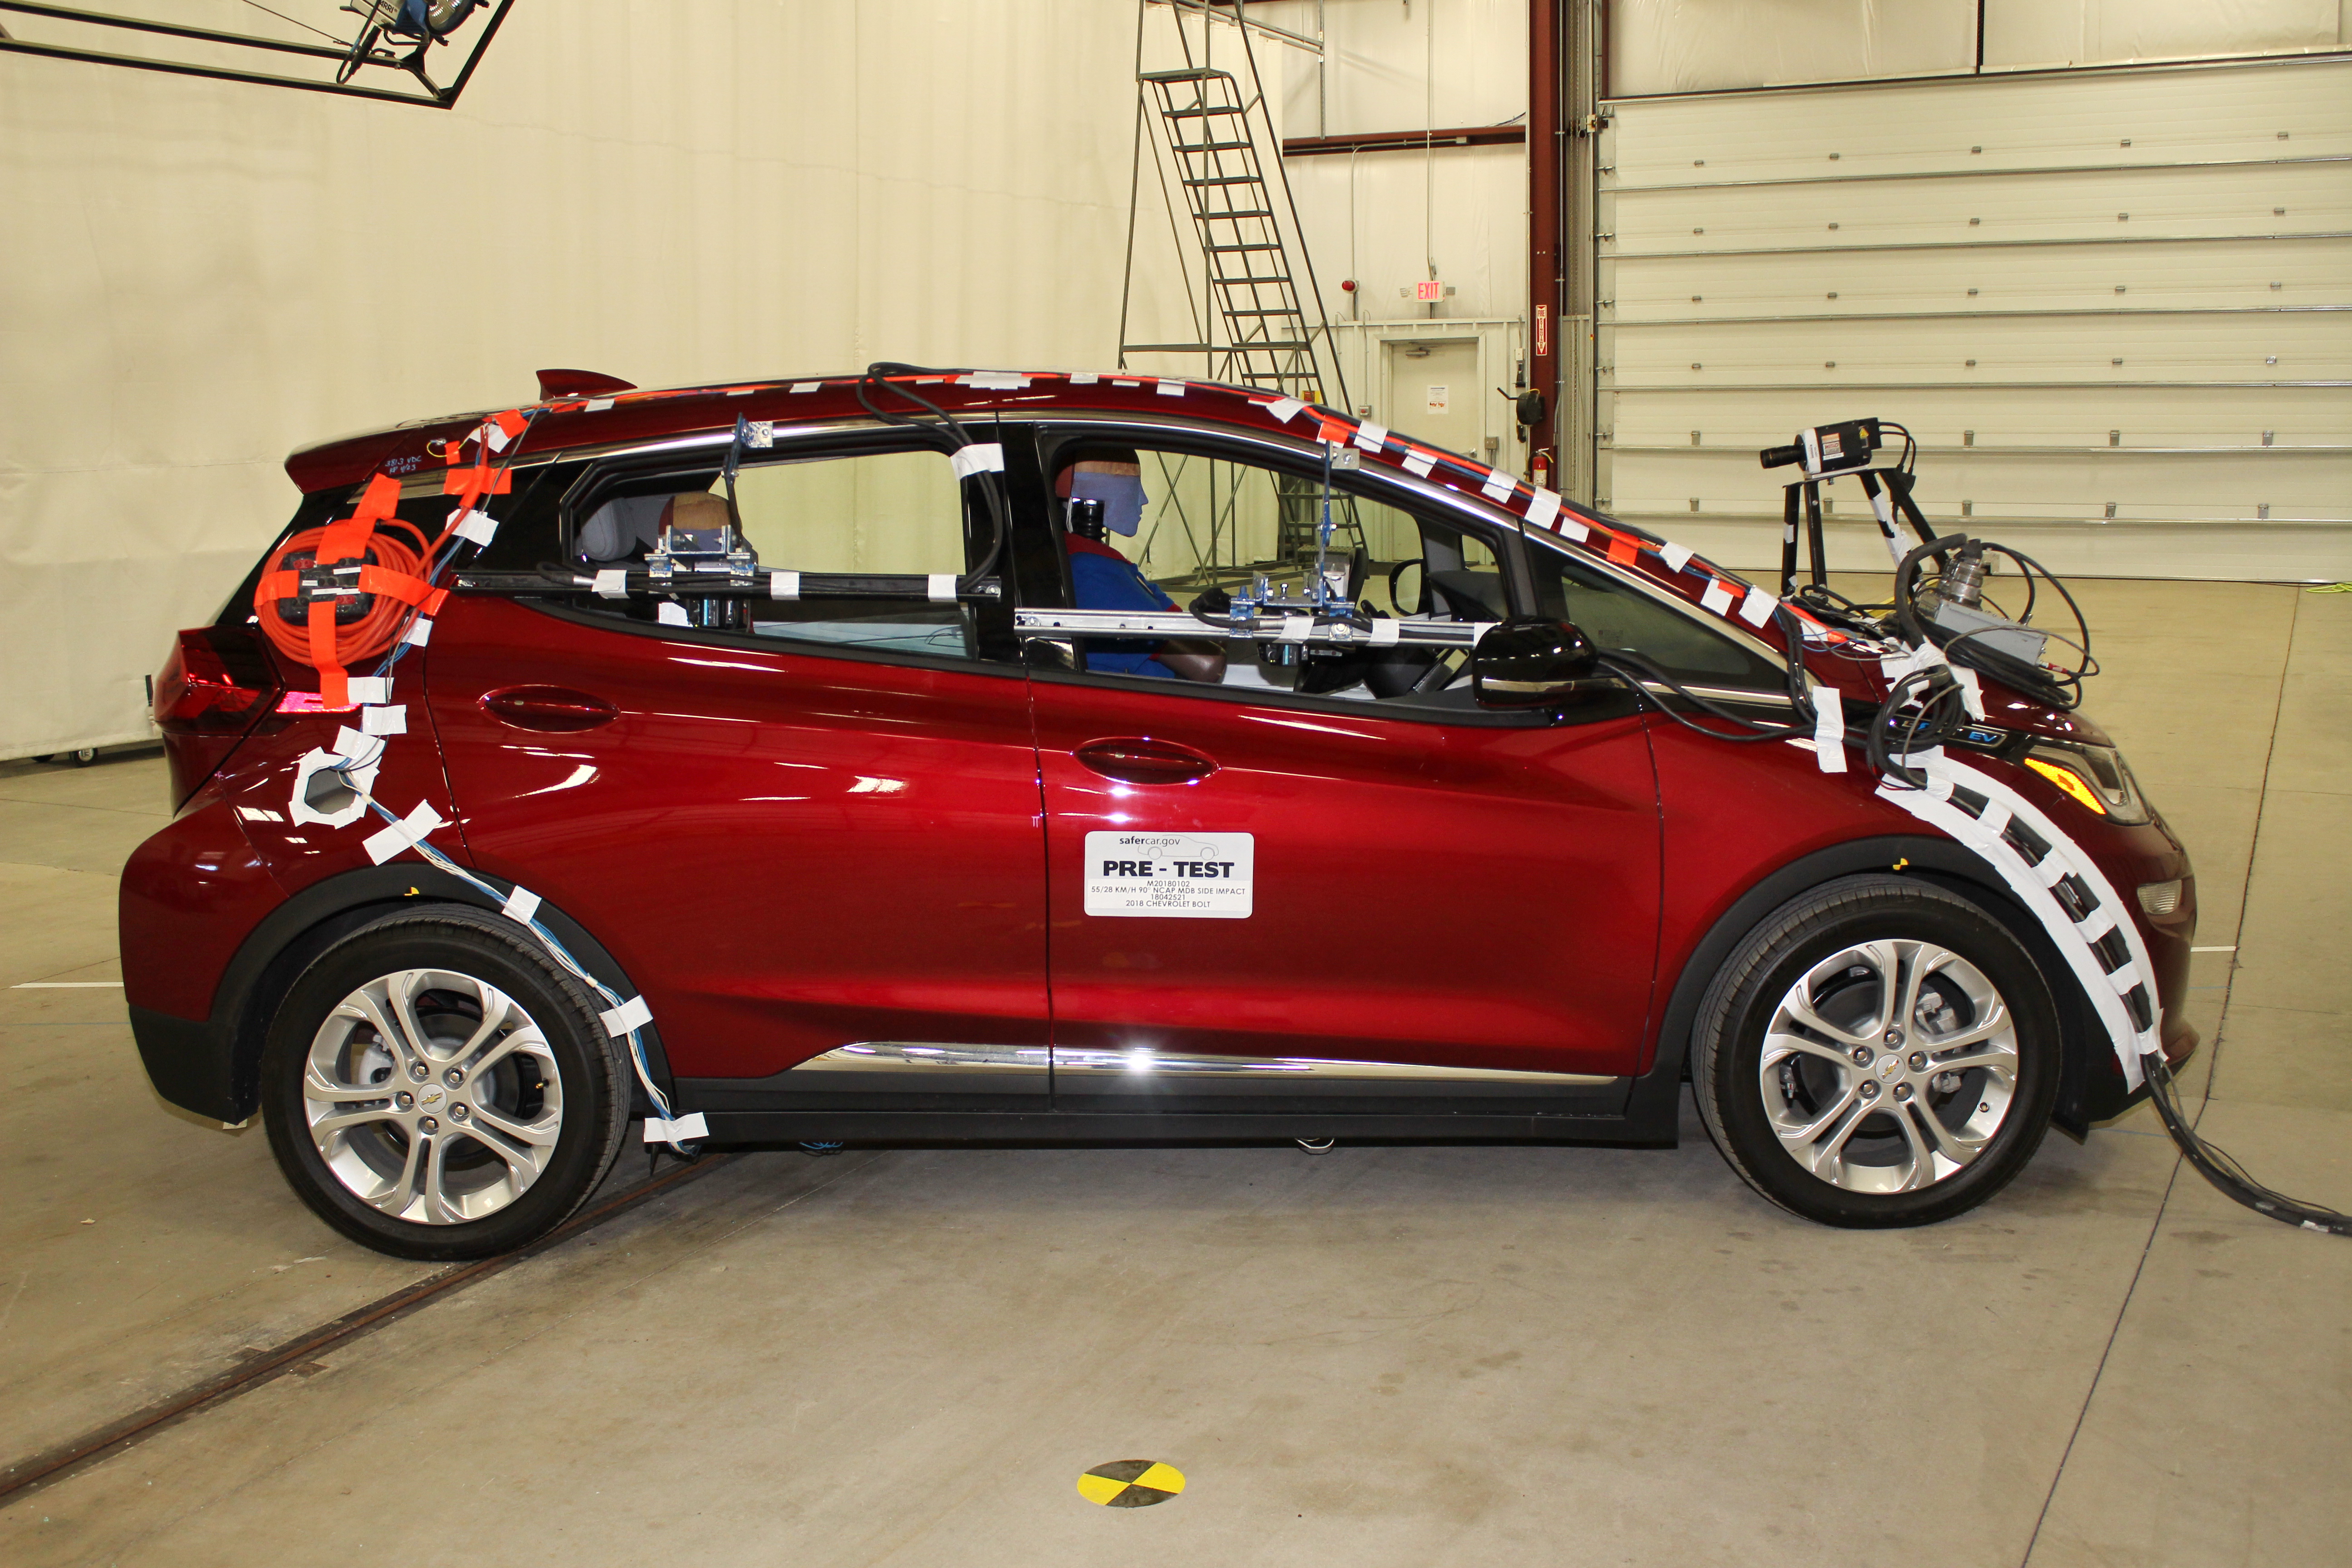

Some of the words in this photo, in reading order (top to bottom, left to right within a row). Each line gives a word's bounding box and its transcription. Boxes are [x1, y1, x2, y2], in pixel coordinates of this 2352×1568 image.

[1418, 282, 1439, 299] EXIT
[1968, 731, 1997, 742] EV
[1119, 836, 1180, 847] safercar.gov
[1103, 860, 1153, 877] PRE
[1173, 861, 1235, 878] TEST
